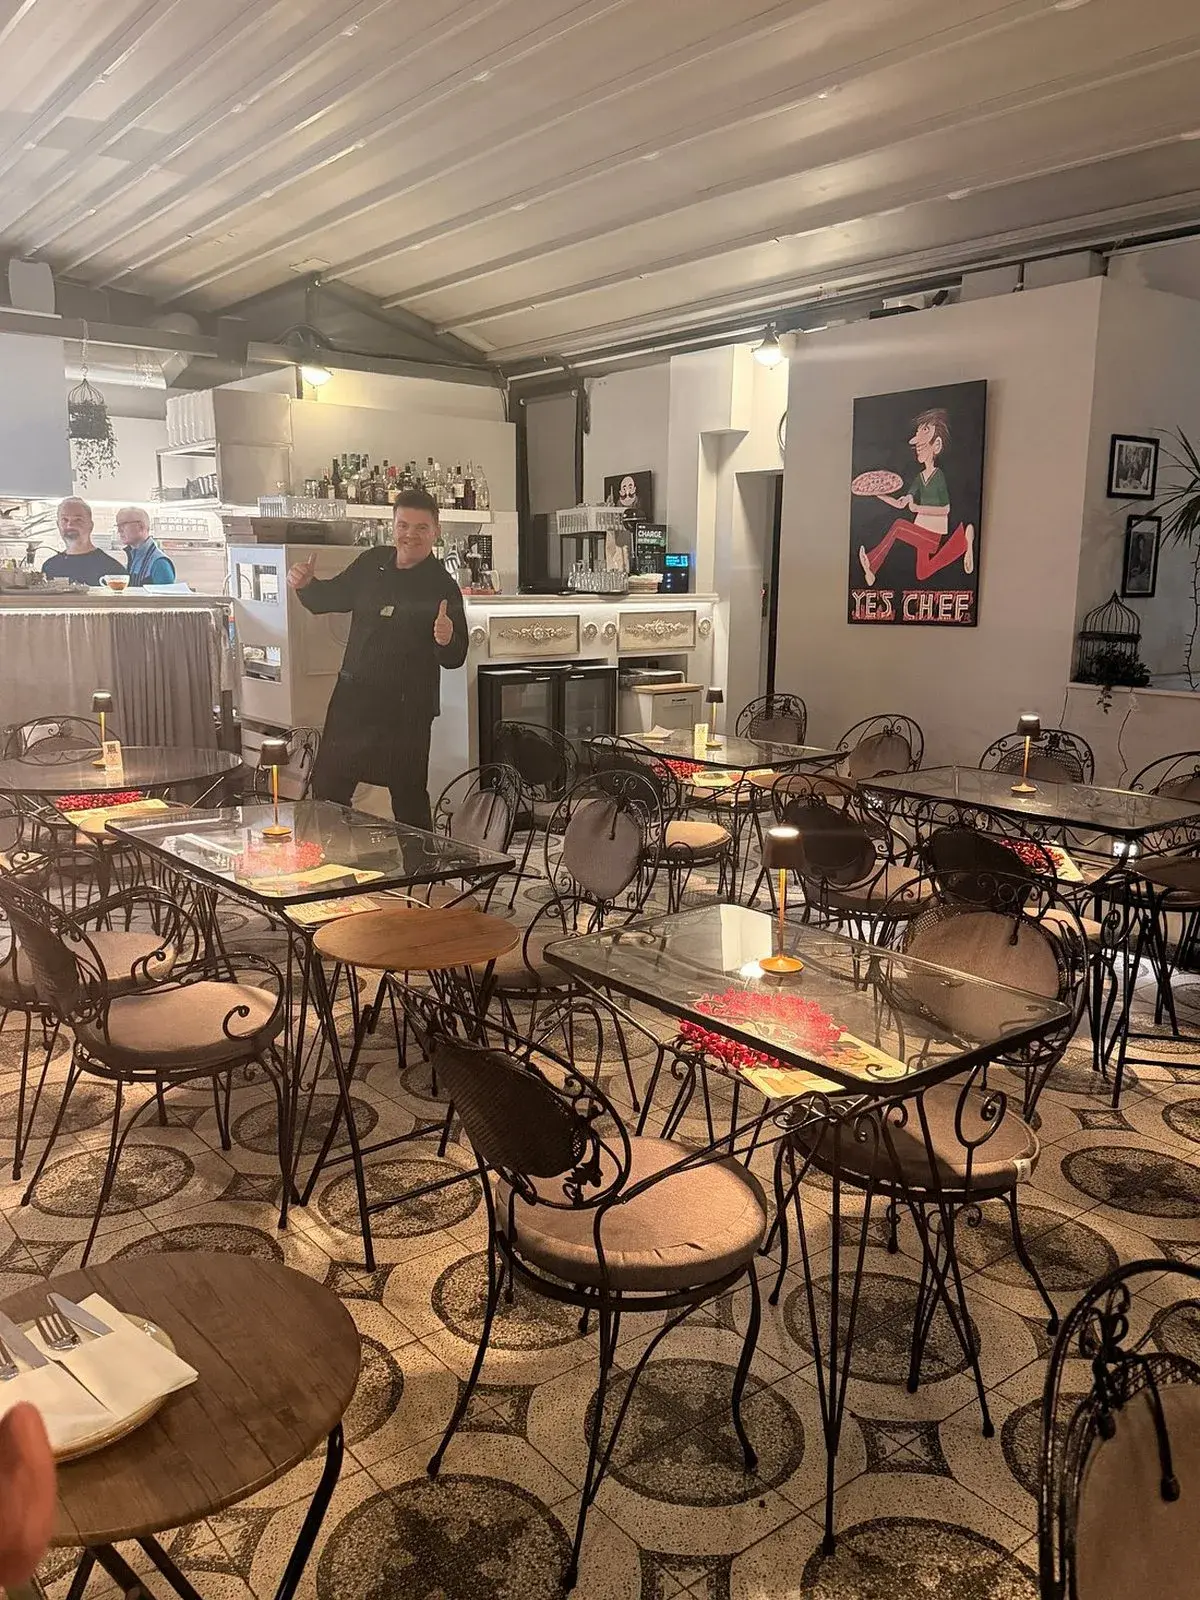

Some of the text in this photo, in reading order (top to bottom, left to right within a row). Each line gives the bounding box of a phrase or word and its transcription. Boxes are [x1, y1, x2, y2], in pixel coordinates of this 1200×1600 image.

[638, 530, 662, 538] CHARGE
[852, 591, 970, 620] YES CHEF
